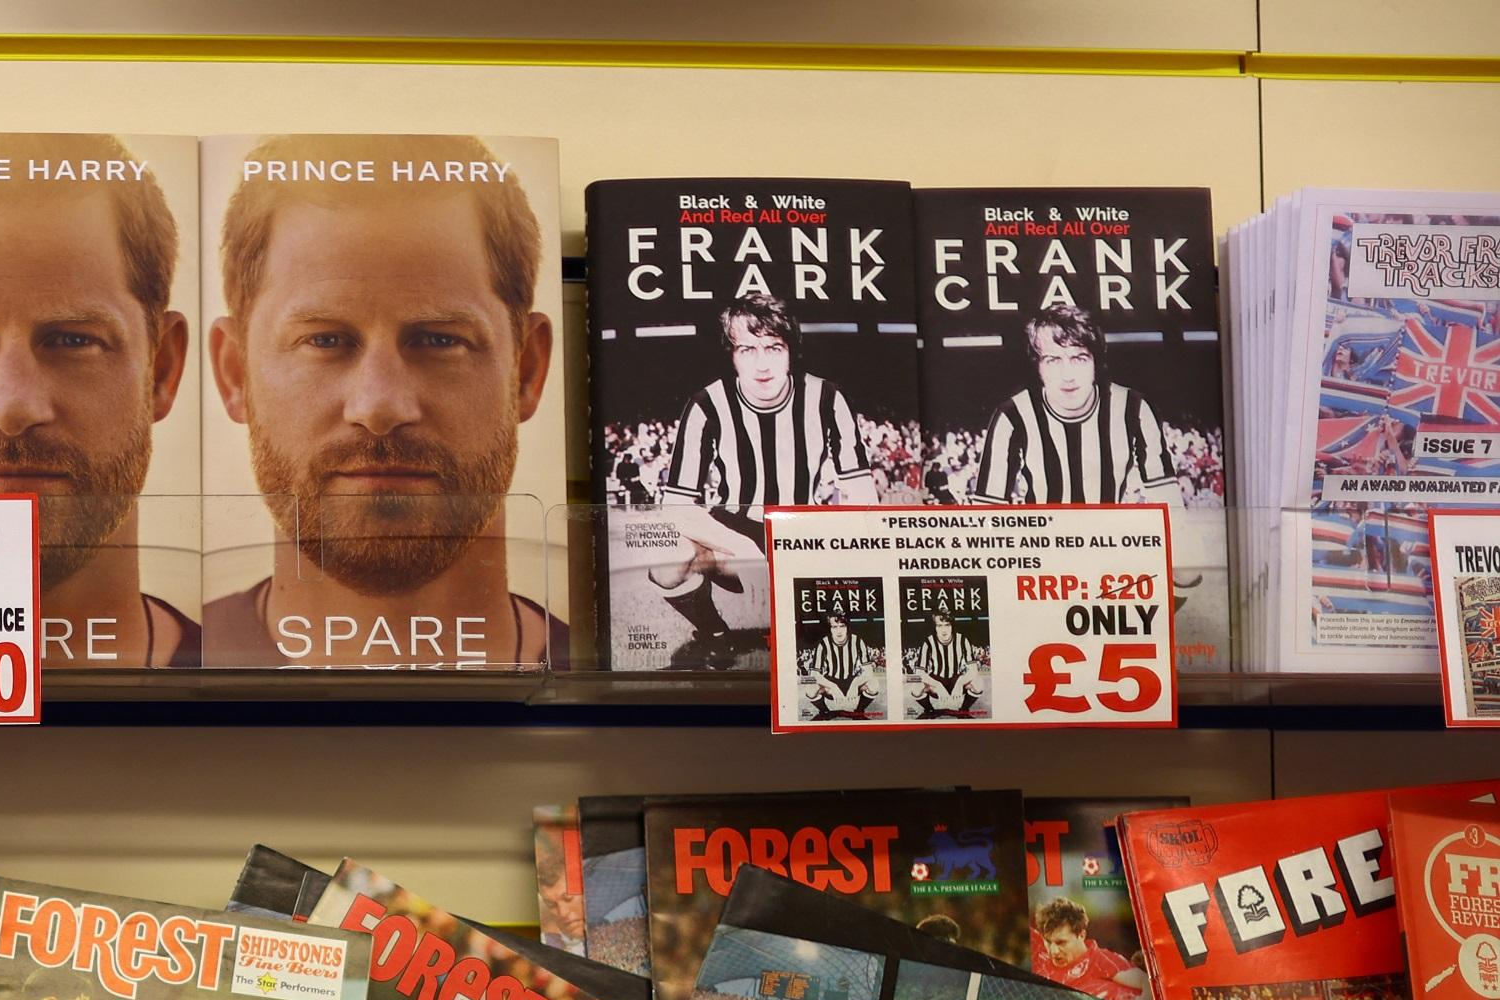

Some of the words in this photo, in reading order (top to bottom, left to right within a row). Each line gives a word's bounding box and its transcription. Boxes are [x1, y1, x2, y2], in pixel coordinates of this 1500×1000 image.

[28, 160, 149, 182] HARRY
[243, 160, 375, 183] PRINCE
[392, 161, 511, 183] HARRY
[679, 195, 731, 210] Black
[745, 196, 758, 210] &
[772, 196, 826, 210] White
[680, 210, 716, 224] And
[720, 210, 753, 224] Red
[758, 210, 782, 224] All
[786, 211, 827, 224] Over
[985, 207, 1035, 221] Black
[1050, 207, 1063, 222] &
[1076, 207, 1130, 221] White
[986, 222, 1022, 236] And
[1025, 222, 1058, 236] Red
[1062, 222, 1086, 236] All
[1089, 222, 1131, 236] Over
[627, 227, 886, 264] FRANK
[1357, 234, 1459, 269] TREVOR
[935, 238, 1191, 275] FRANK
[627, 264, 887, 300] CLARK
[1376, 262, 1500, 297] TRACKS
[935, 274, 1192, 311] CLARK
[1413, 360, 1498, 390] TREVOR
[1481, 439, 1492, 454] 7
[1340, 479, 1358, 492] AN
[1361, 480, 1406, 492] AWARD
[1409, 481, 1486, 493] NOMINATED
[625, 523, 676, 532] FOREWORD
[625, 532, 638, 540] BY
[639, 531, 681, 539] HOWARD
[774, 539, 825, 550] FRANK
[830, 538, 891, 550] CLARKE
[895, 537, 947, 549] BLACK
[951, 537, 961, 549] &
[966, 537, 1015, 549] WHITE
[1020, 537, 1050, 548] AND
[1055, 536, 1085, 548] RED
[1089, 536, 1117, 548] ALL
[1121, 536, 1162, 547] OVER
[625, 540, 678, 548] WILKINSON
[898, 558, 982, 570] HARDBACK
[987, 557, 1042, 569] COPIES
[801, 589, 876, 600] FRANK
[907, 588, 981, 599] FRANK
[1016, 575, 1088, 600] RRP:
[1098, 574, 1155, 600] £20
[801, 600, 877, 612] CLARK
[907, 599, 981, 611] CLARK
[1065, 605, 1159, 636] ONLY
[627, 625, 650, 633] WITH
[276, 615, 487, 662] SPARE
[628, 634, 658, 642] TERRY
[628, 642, 667, 650] BOWLES
[1023, 643, 1162, 713] £5
[240, 934, 342, 966] SHIPSTONES
[238, 956, 283, 971] Fine
[286, 962, 338, 979] Beers
[236, 976, 254, 986] The
[257, 978, 277, 988] Star
[280, 981, 336, 996] Performers
